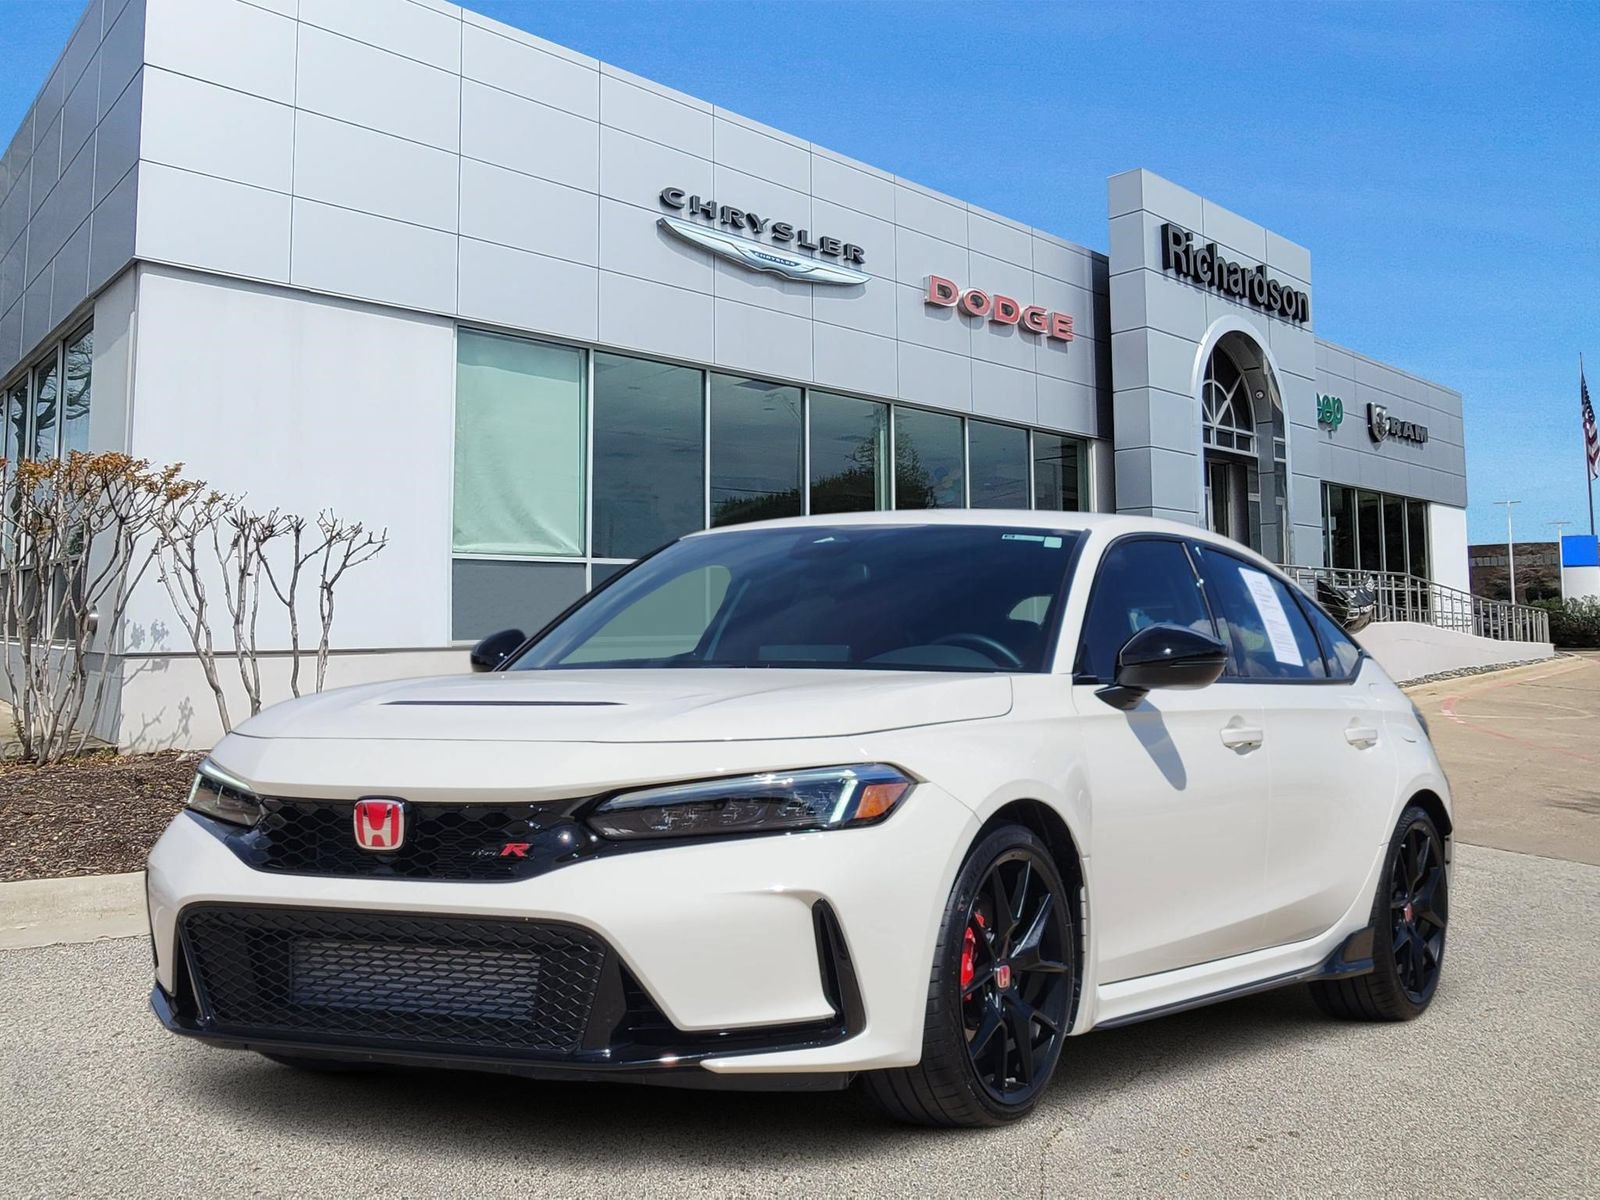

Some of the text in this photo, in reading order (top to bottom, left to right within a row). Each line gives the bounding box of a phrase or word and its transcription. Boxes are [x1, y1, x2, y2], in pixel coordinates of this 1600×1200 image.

[659, 186, 866, 264] CHRYSLER
[923, 274, 1074, 343] DODGE
[1161, 222, 1310, 323] Richardson
[1388, 416, 1429, 444] RAM
